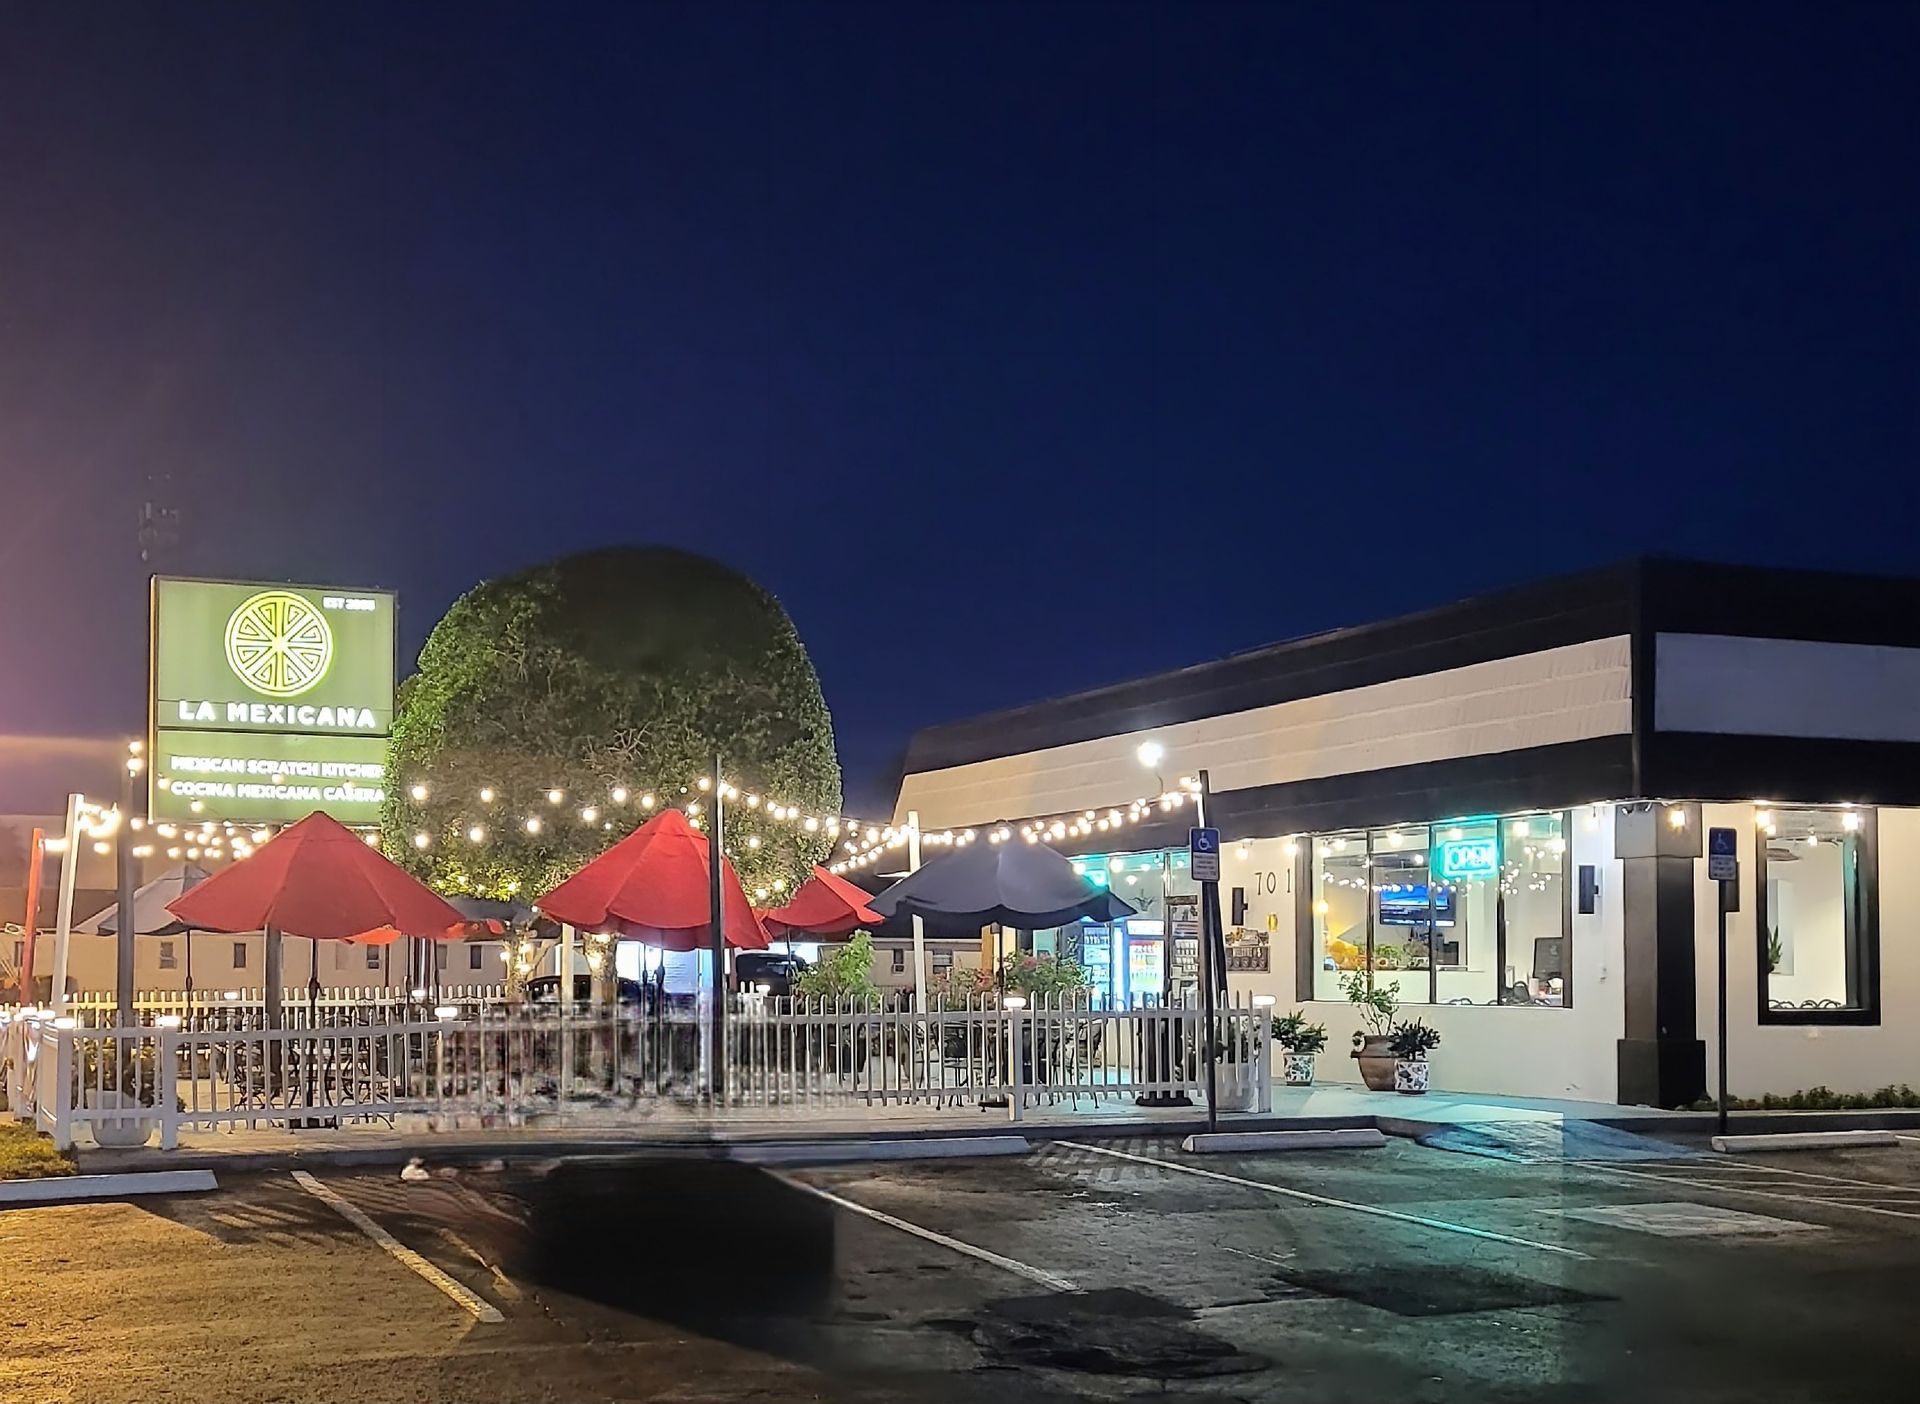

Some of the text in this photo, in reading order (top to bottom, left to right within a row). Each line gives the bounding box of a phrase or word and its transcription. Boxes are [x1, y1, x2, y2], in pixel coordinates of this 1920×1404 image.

[179, 700, 377, 729] LA MEXICANA
[247, 759, 320, 777] SCRATCH
[170, 781, 235, 798] COCINA
[237, 783, 321, 801] MEXICANA
[1254, 868, 1291, 896] 701
